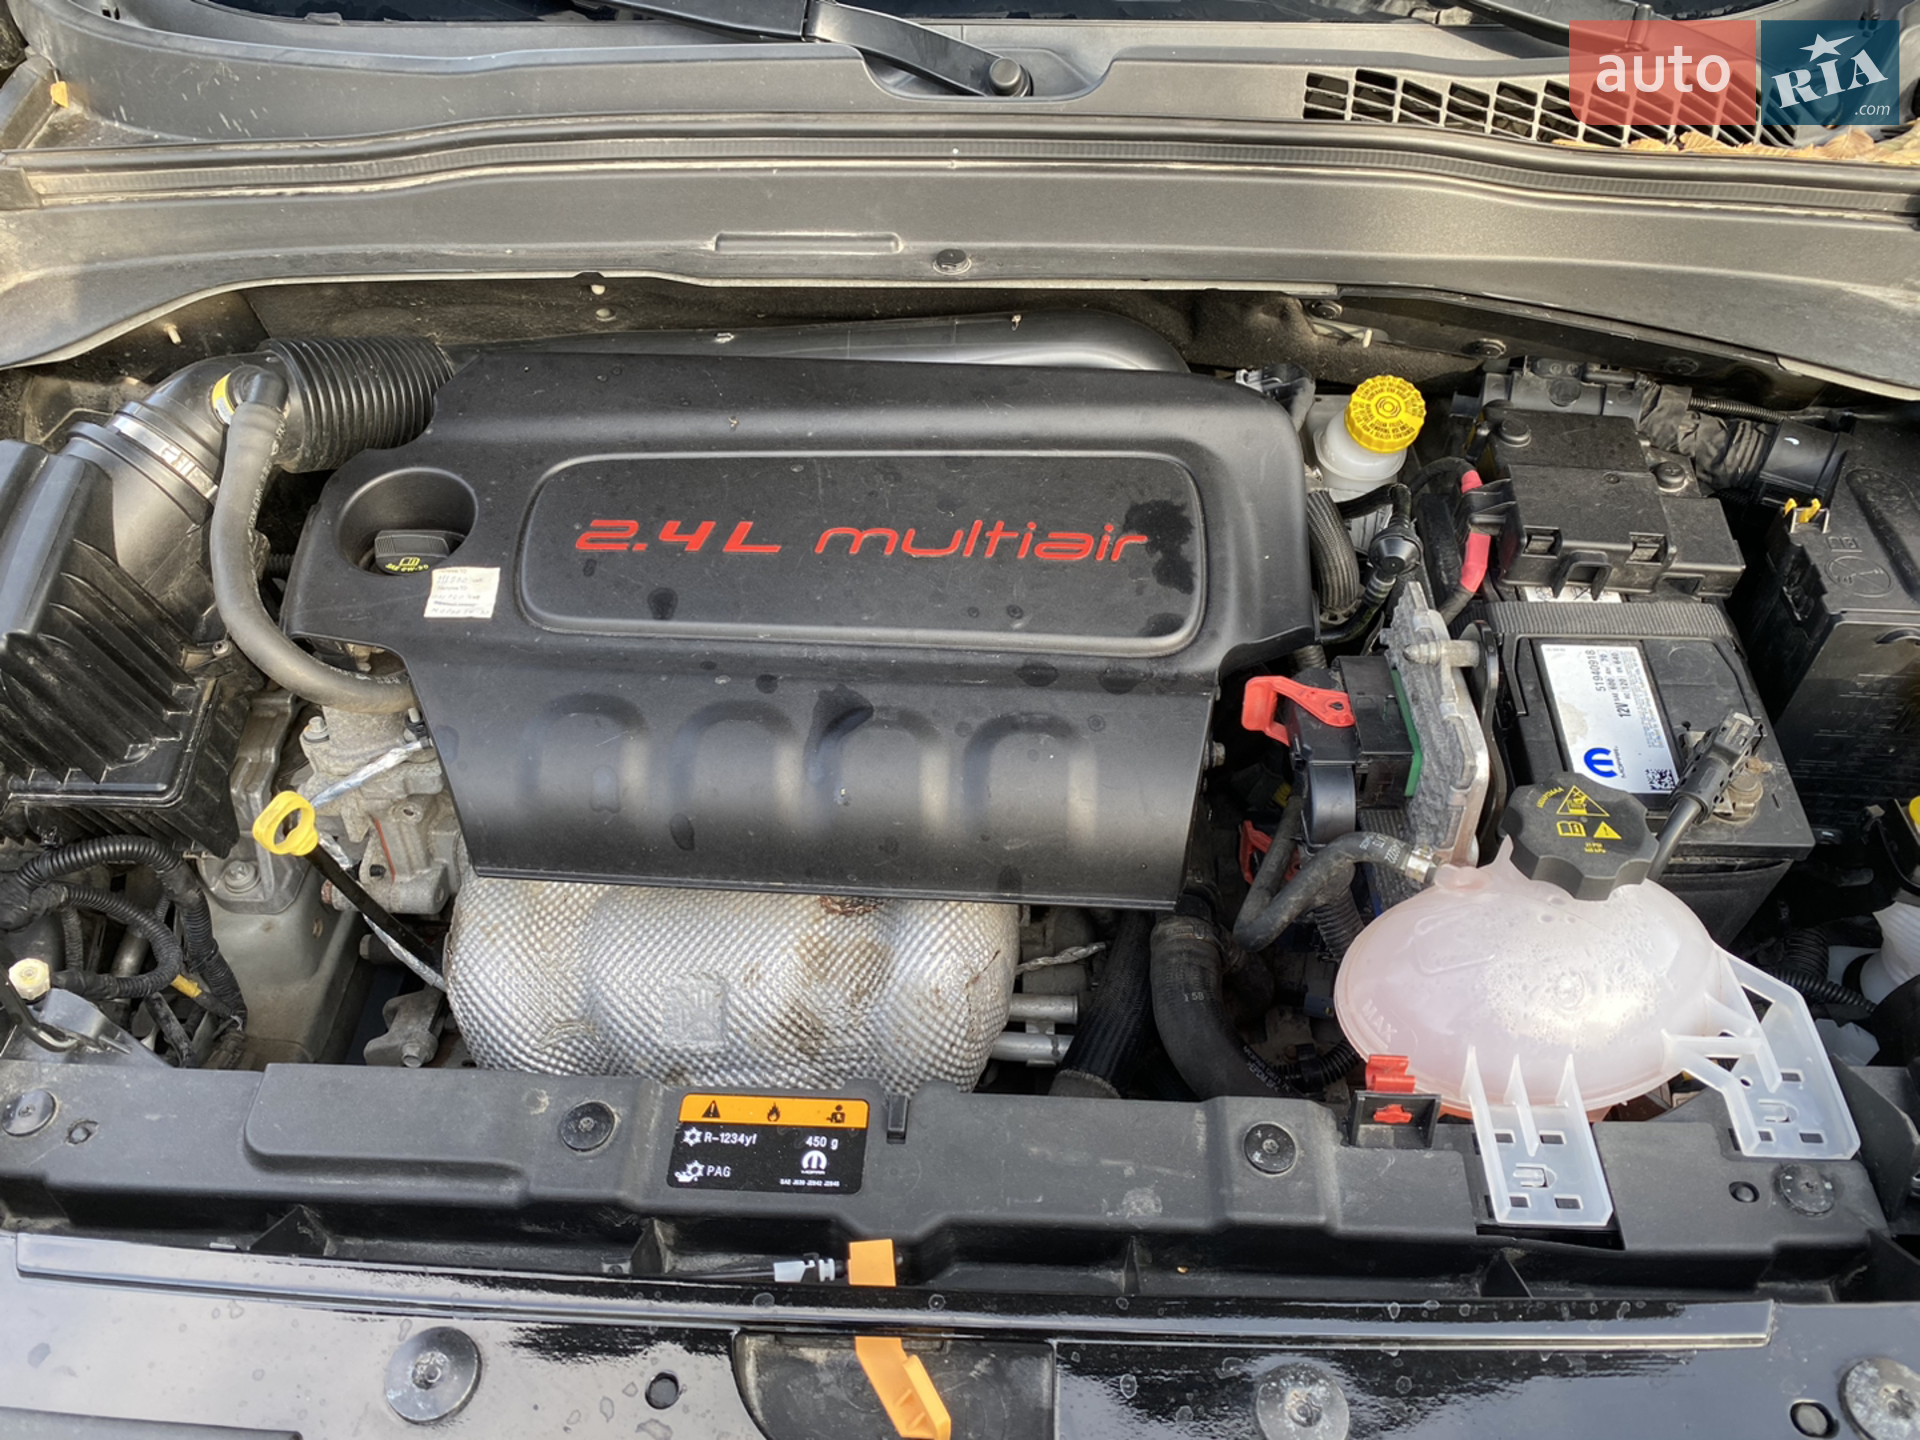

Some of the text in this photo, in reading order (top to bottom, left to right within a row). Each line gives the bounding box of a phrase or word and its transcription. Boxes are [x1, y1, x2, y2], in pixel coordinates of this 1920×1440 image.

[575, 519, 1150, 562] 2.4L multiair
[1584, 648, 1607, 692] 51940918
[1618, 677, 1630, 690] 120
[1614, 701, 1632, 718] 12V
[1361, 998, 1398, 1044] MAX
[704, 1132, 839, 1150] R-1234yf 450 g
[706, 1165, 732, 1178] PAG
